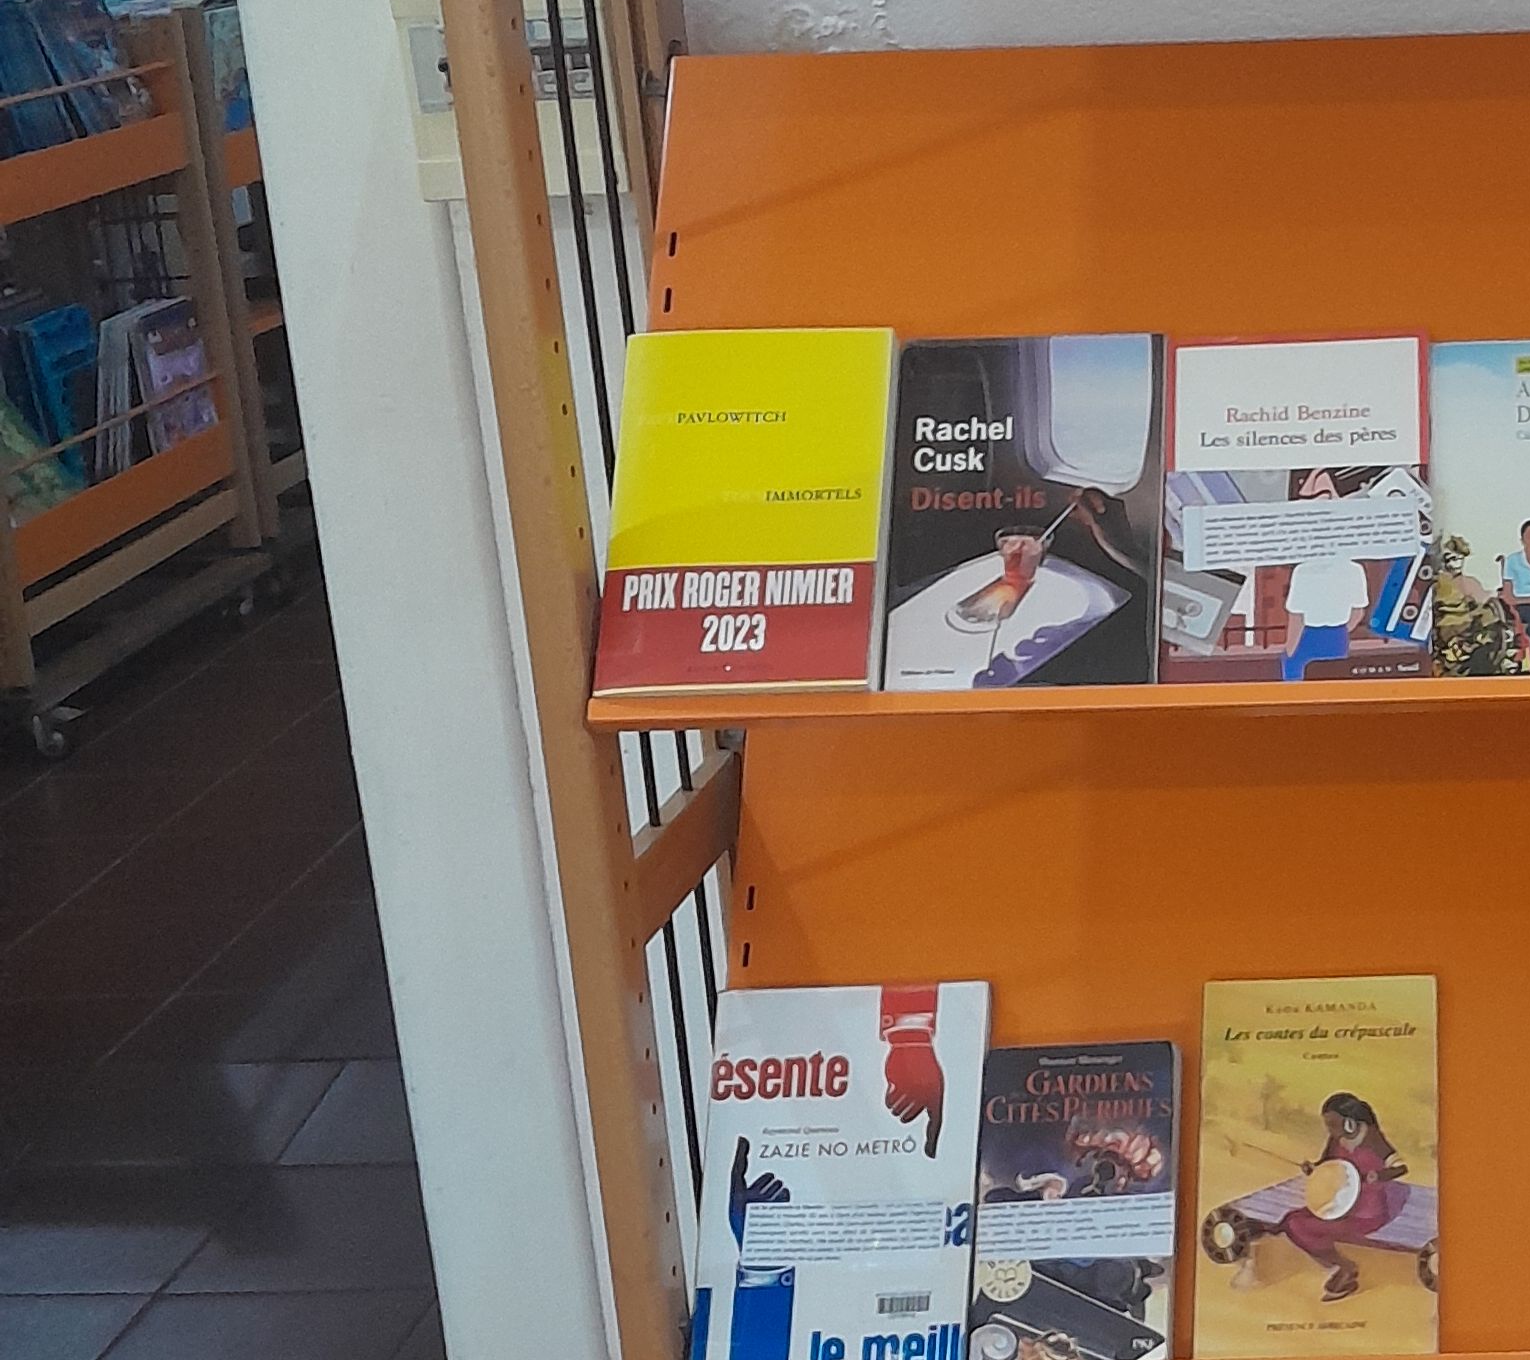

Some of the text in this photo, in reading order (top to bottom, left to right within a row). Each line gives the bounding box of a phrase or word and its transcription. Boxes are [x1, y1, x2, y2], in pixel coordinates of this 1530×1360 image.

[1517, 380, 1530, 398] A
[677, 411, 787, 424] PAVLOWITCH
[1226, 405, 1371, 423] Rachid Benzine
[915, 416, 1014, 442] Rachel
[1200, 428, 1397, 448] Les silences des pères
[913, 446, 985, 473] Cusk
[766, 488, 862, 502] IMMORTELS
[911, 487, 1047, 512] Disent-ils
[622, 568, 854, 612] PRIX ROGER NIMIER
[701, 613, 767, 653] 2023
[1304, 1002, 1377, 1013] KAMANDA
[1224, 1023, 1417, 1042] Les contes du crépuscule
[1025, 1069, 1153, 1097] GARDIENS
[759, 1134, 917, 1159] ZAZIE NO METRÔ
